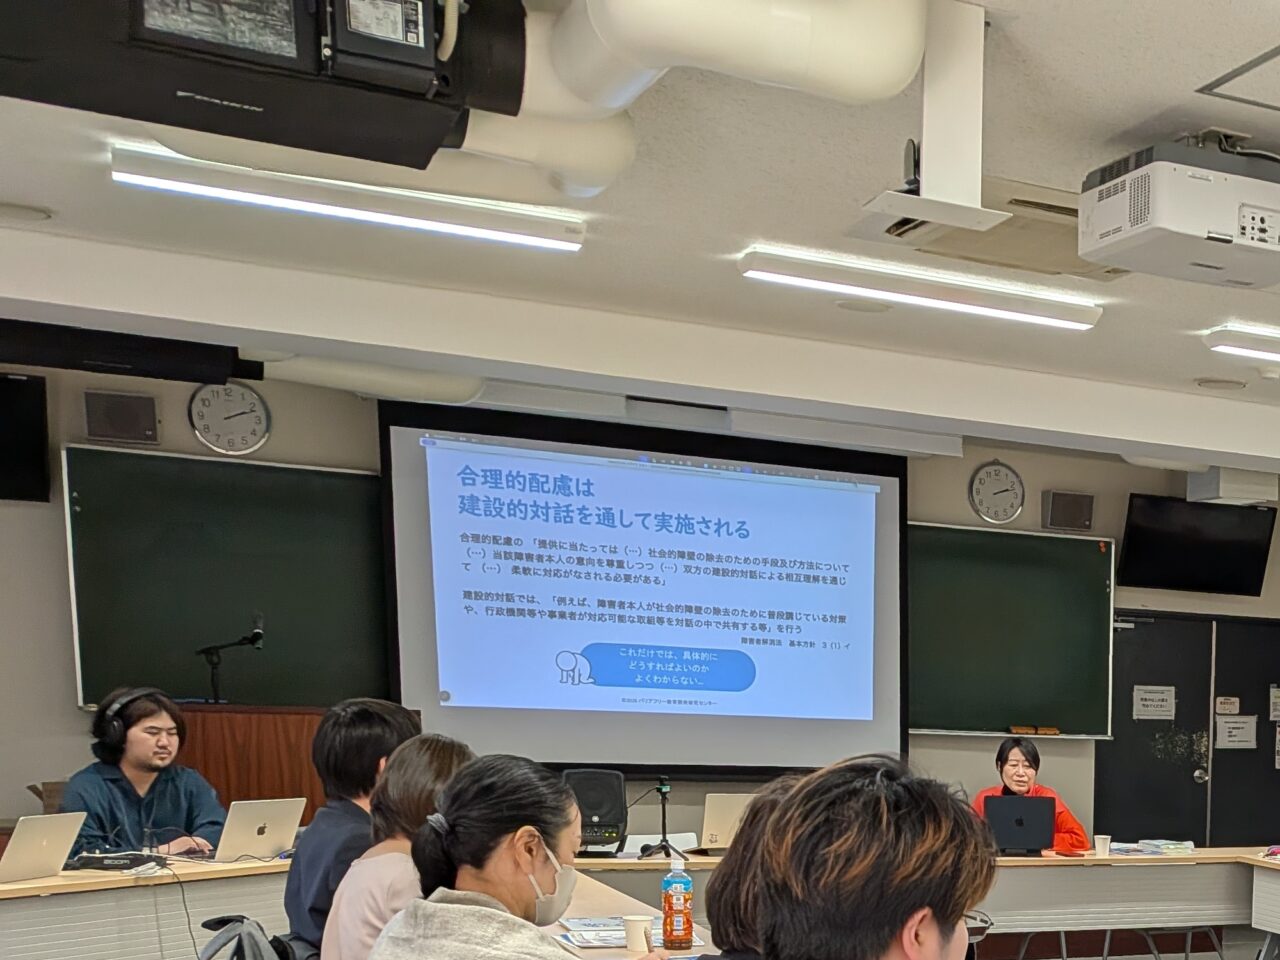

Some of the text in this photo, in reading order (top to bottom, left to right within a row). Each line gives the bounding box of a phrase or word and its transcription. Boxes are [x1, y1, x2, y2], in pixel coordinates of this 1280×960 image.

[457, 464, 595, 497] 合理的配慮は
[458, 494, 750, 539] 建設的対話を通して実施される
[619, 647, 719, 662] これだけでは、具体的に
[628, 660, 710, 673] どうすればよいのか
